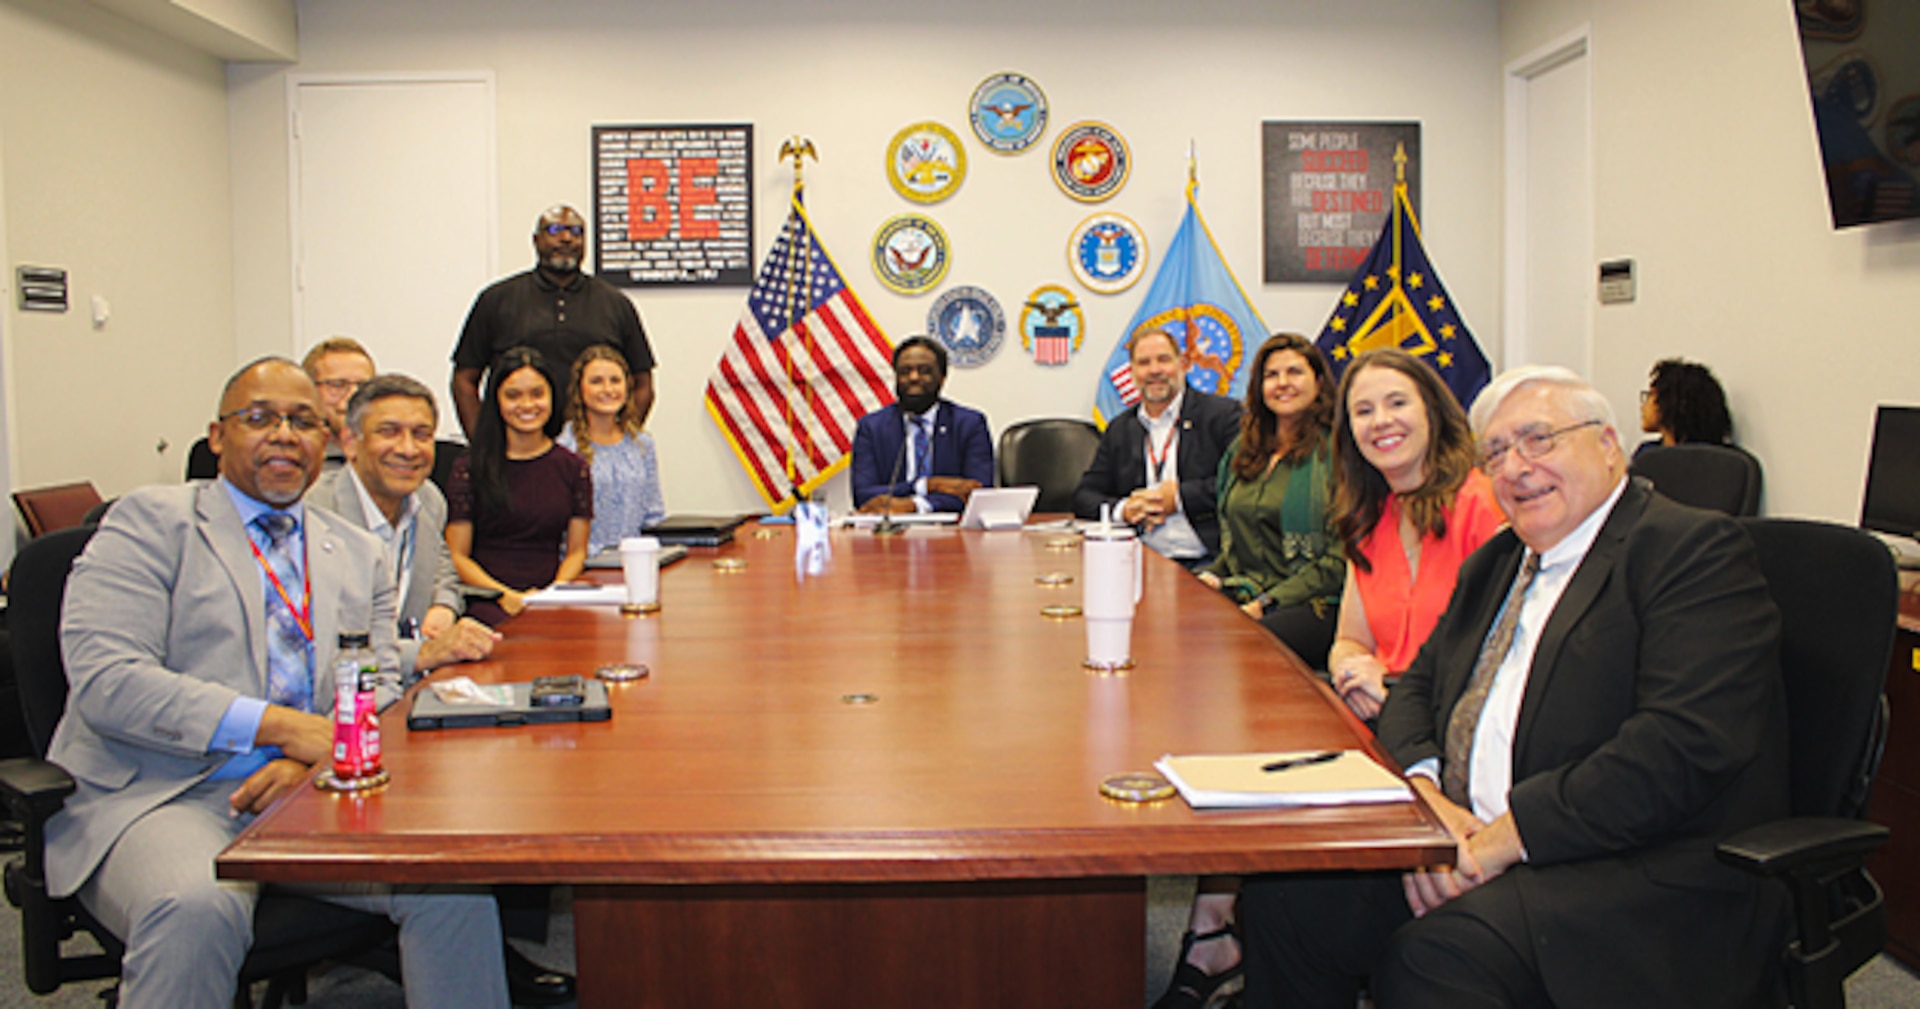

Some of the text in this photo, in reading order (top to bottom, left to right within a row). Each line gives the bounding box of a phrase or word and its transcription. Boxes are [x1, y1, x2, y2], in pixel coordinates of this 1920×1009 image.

[1288, 131, 1358, 150] SOME PEOPLE
[1302, 149, 1369, 173] SUCCEED
[1290, 172, 1367, 190] BECAUSE THEY
[627, 157, 720, 240] BE
[1313, 190, 1383, 213] DESTINED
[1298, 211, 1352, 229] BUT MOST
[1298, 229, 1343, 247] BECAUSE
[1305, 246, 1372, 271] DETERM
